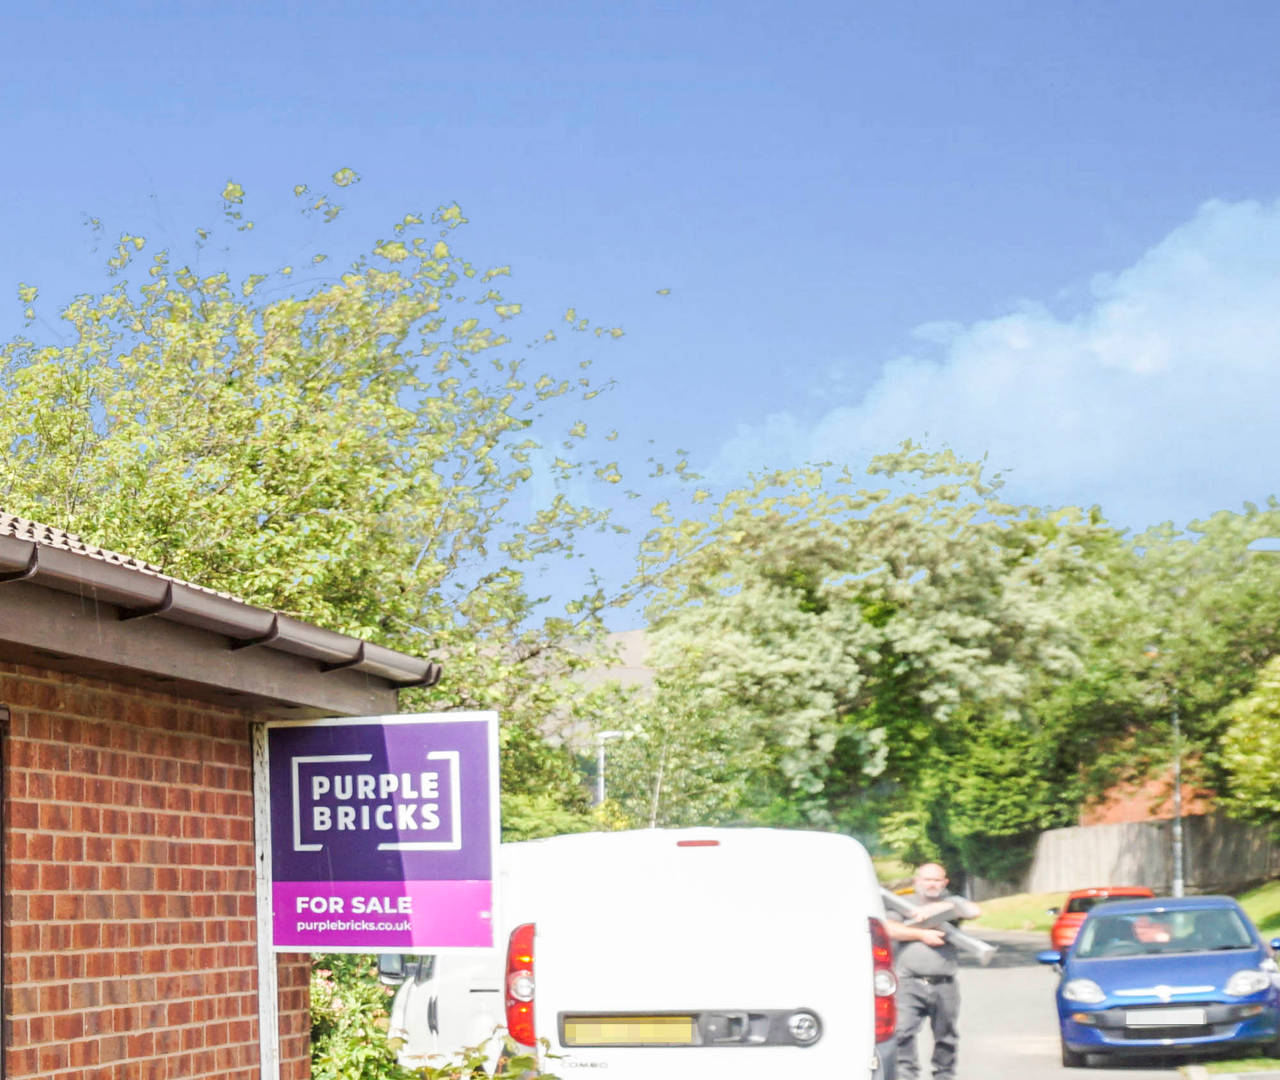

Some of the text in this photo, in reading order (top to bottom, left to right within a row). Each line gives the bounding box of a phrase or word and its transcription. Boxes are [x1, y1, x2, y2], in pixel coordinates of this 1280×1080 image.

[312, 772, 439, 800] PURPLE
[313, 803, 440, 831] BRICKS
[296, 896, 413, 914] FOR SALE
[297, 920, 412, 932] purplebricks.co.uk
